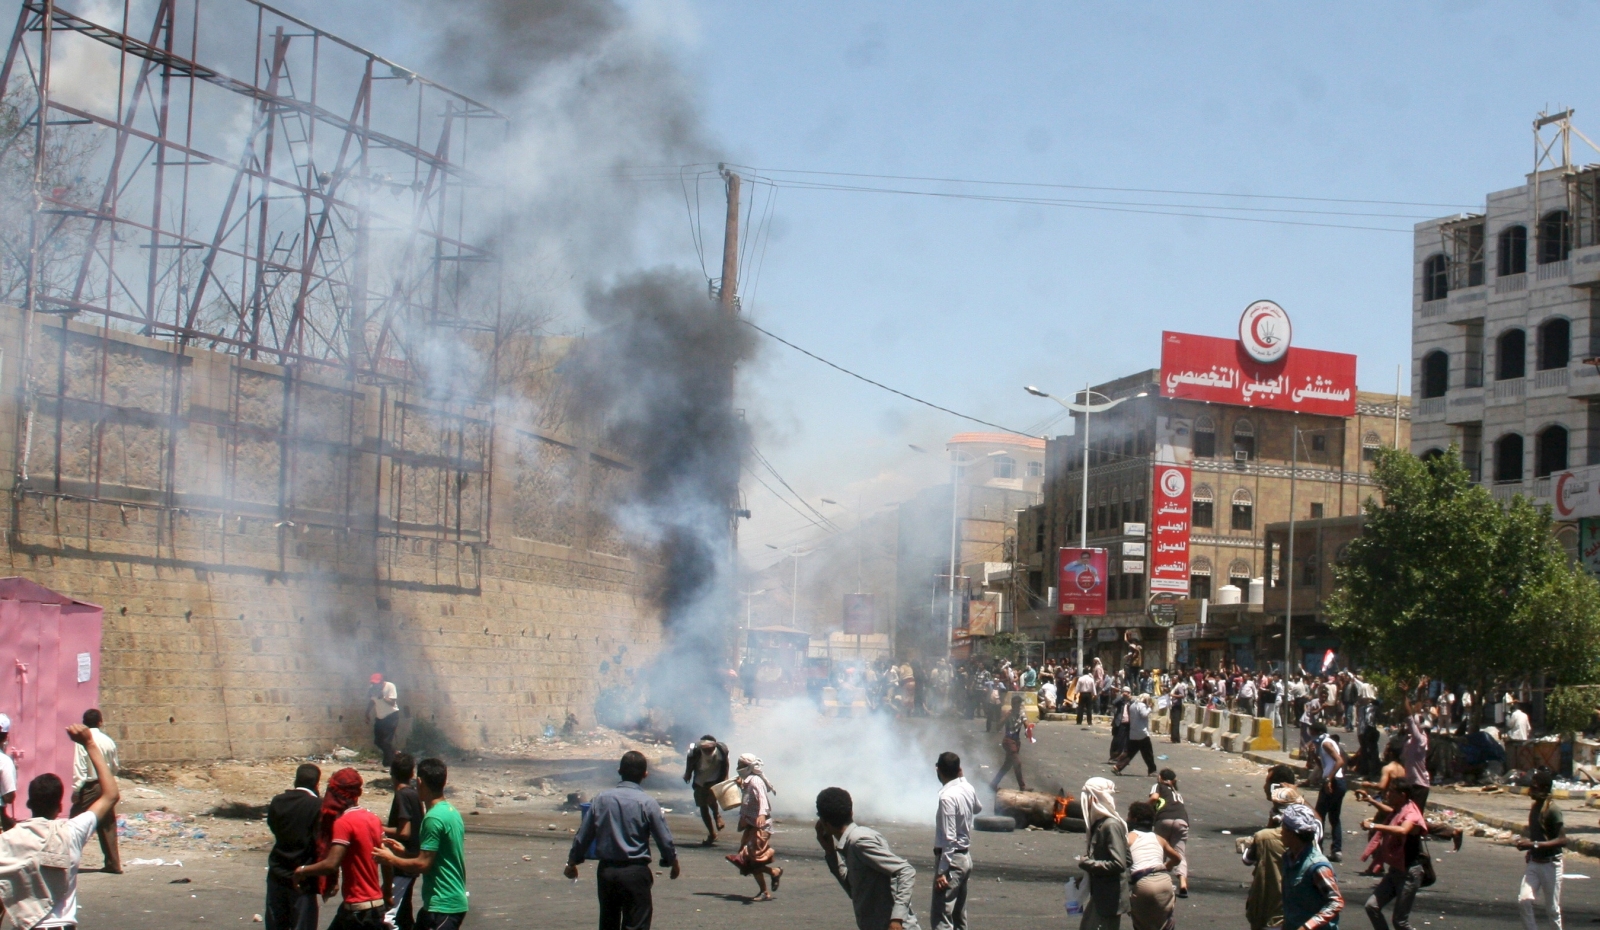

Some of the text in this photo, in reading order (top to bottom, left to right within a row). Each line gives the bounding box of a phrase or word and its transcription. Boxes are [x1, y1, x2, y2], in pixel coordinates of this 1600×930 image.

[1166, 365, 1351, 403] مستشفى الجبلي التخصصي
[1157, 501, 1187, 515] مستشفى
[1157, 520, 1187, 534] الجبلي
[1157, 540, 1186, 553] للعيون
[1155, 561, 1187, 575] التخصصي
